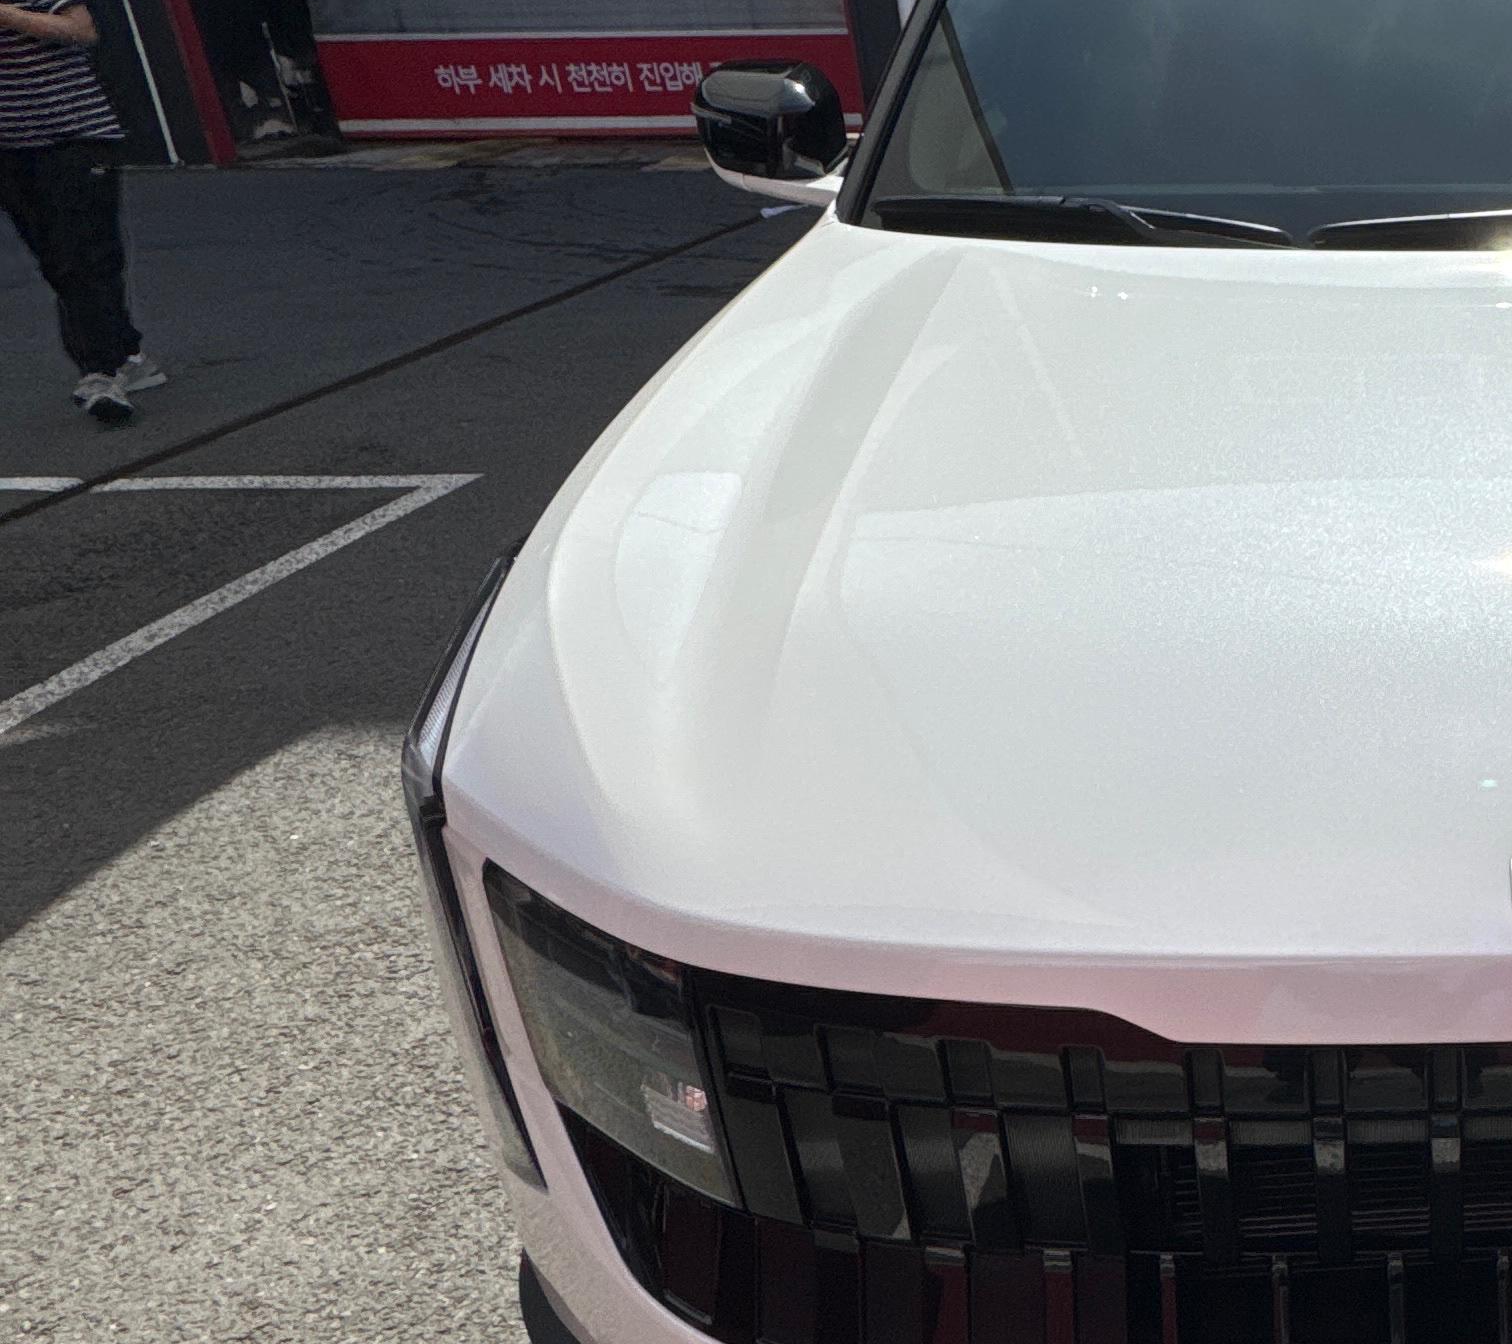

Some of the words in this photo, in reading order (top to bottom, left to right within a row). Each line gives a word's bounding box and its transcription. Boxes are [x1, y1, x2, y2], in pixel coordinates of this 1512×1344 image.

[434, 64, 482, 94] 하부
[488, 63, 532, 94] 세차
[538, 63, 563, 94] 시
[565, 62, 634, 93] 천천히
